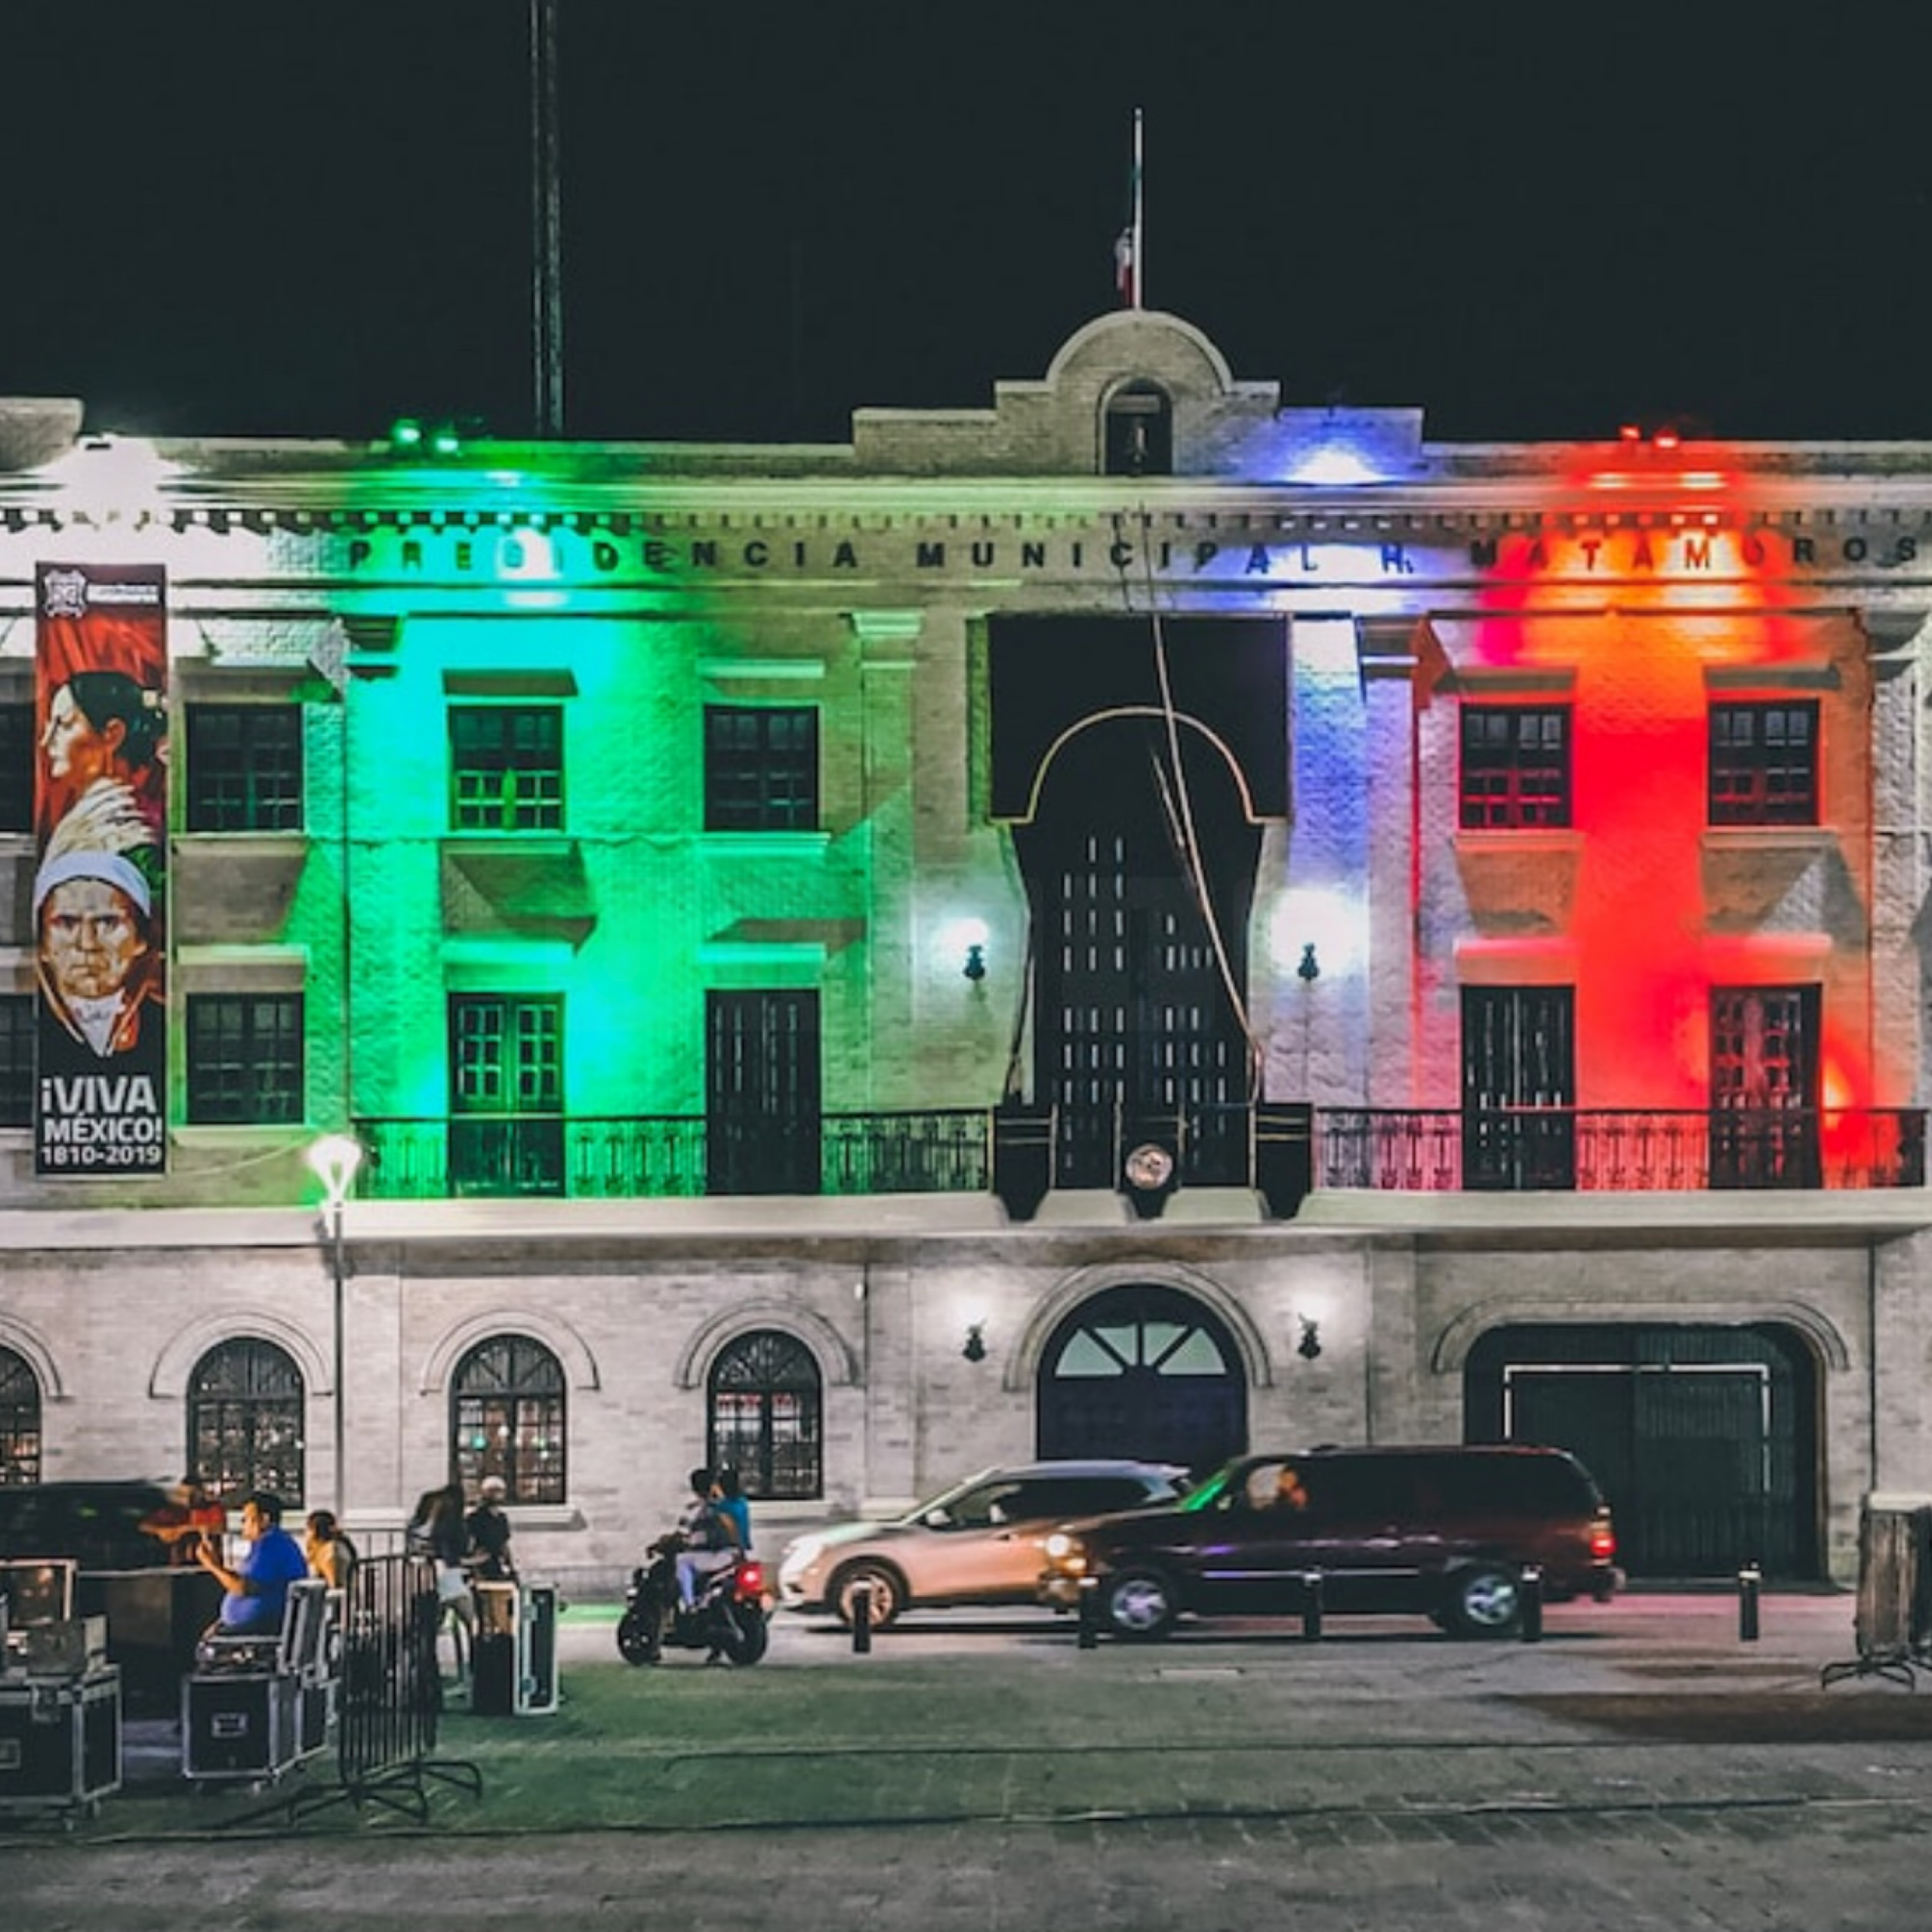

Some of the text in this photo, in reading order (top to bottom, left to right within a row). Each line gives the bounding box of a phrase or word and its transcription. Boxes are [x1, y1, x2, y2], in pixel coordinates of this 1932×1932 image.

[917, 541, 1319, 574] MUNICIPAL
[1471, 536, 1917, 572] MATAMOROS
[42, 1076, 157, 1113] ¡VIVA
[43, 1112, 162, 1144] MÉXICO!
[42, 1145, 162, 1165] 1810-2019
